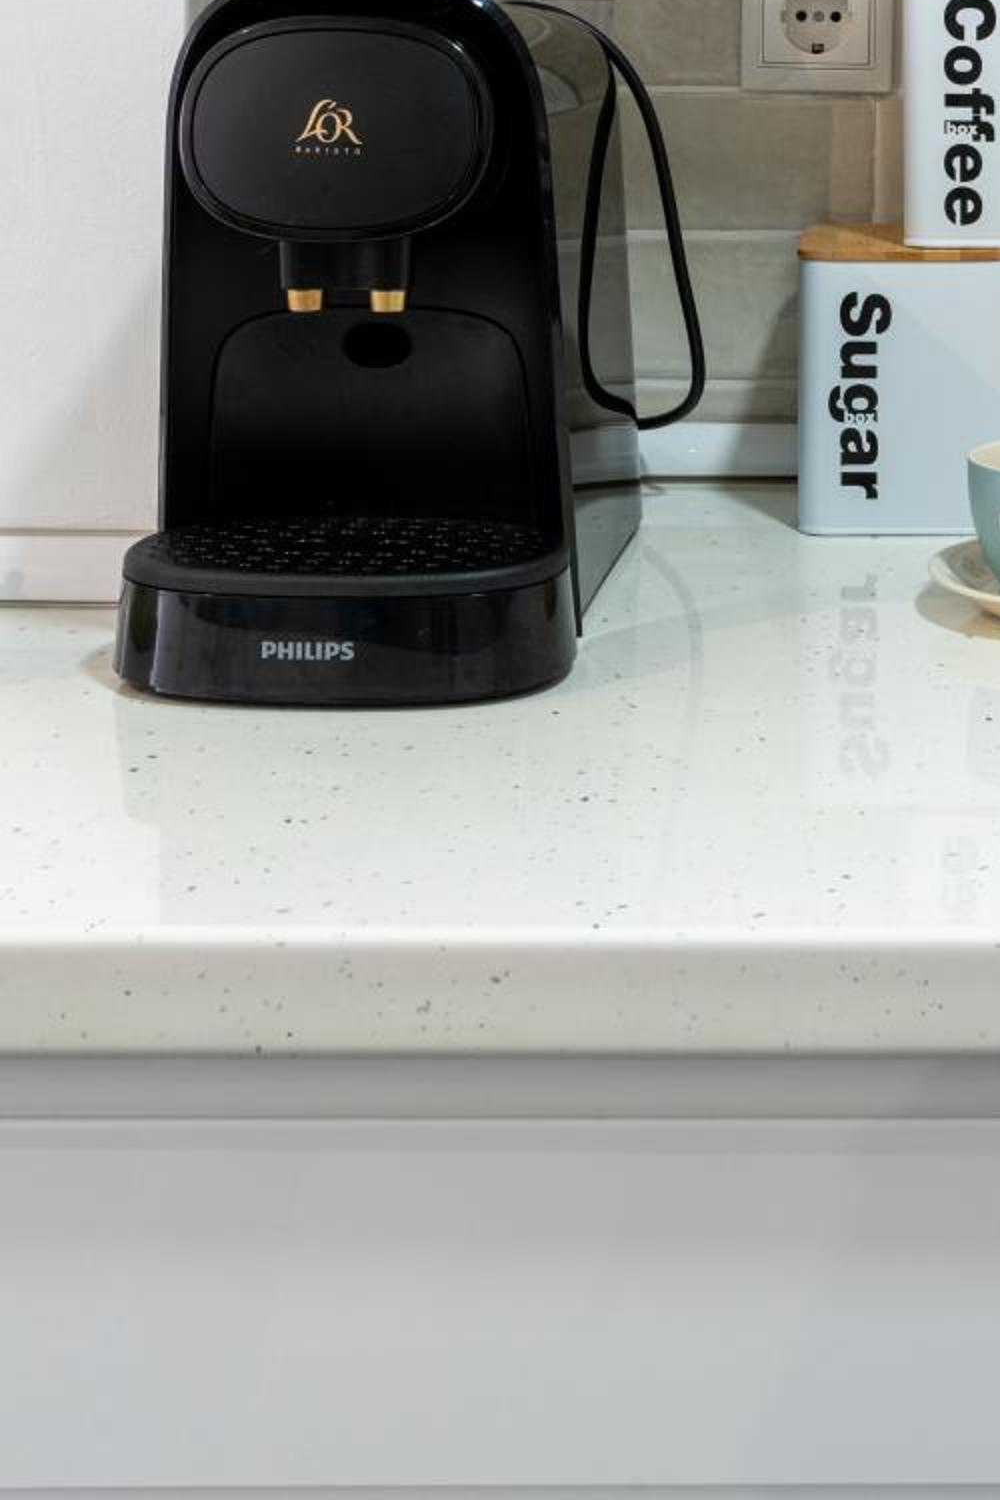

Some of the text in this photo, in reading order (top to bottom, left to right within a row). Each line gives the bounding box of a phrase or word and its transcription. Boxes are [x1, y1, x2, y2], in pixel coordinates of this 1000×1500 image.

[944, 120, 980, 137] box
[827, 290, 893, 500] Sugar
[843, 408, 877, 426] box
[260, 640, 355, 661] PHILIPS
